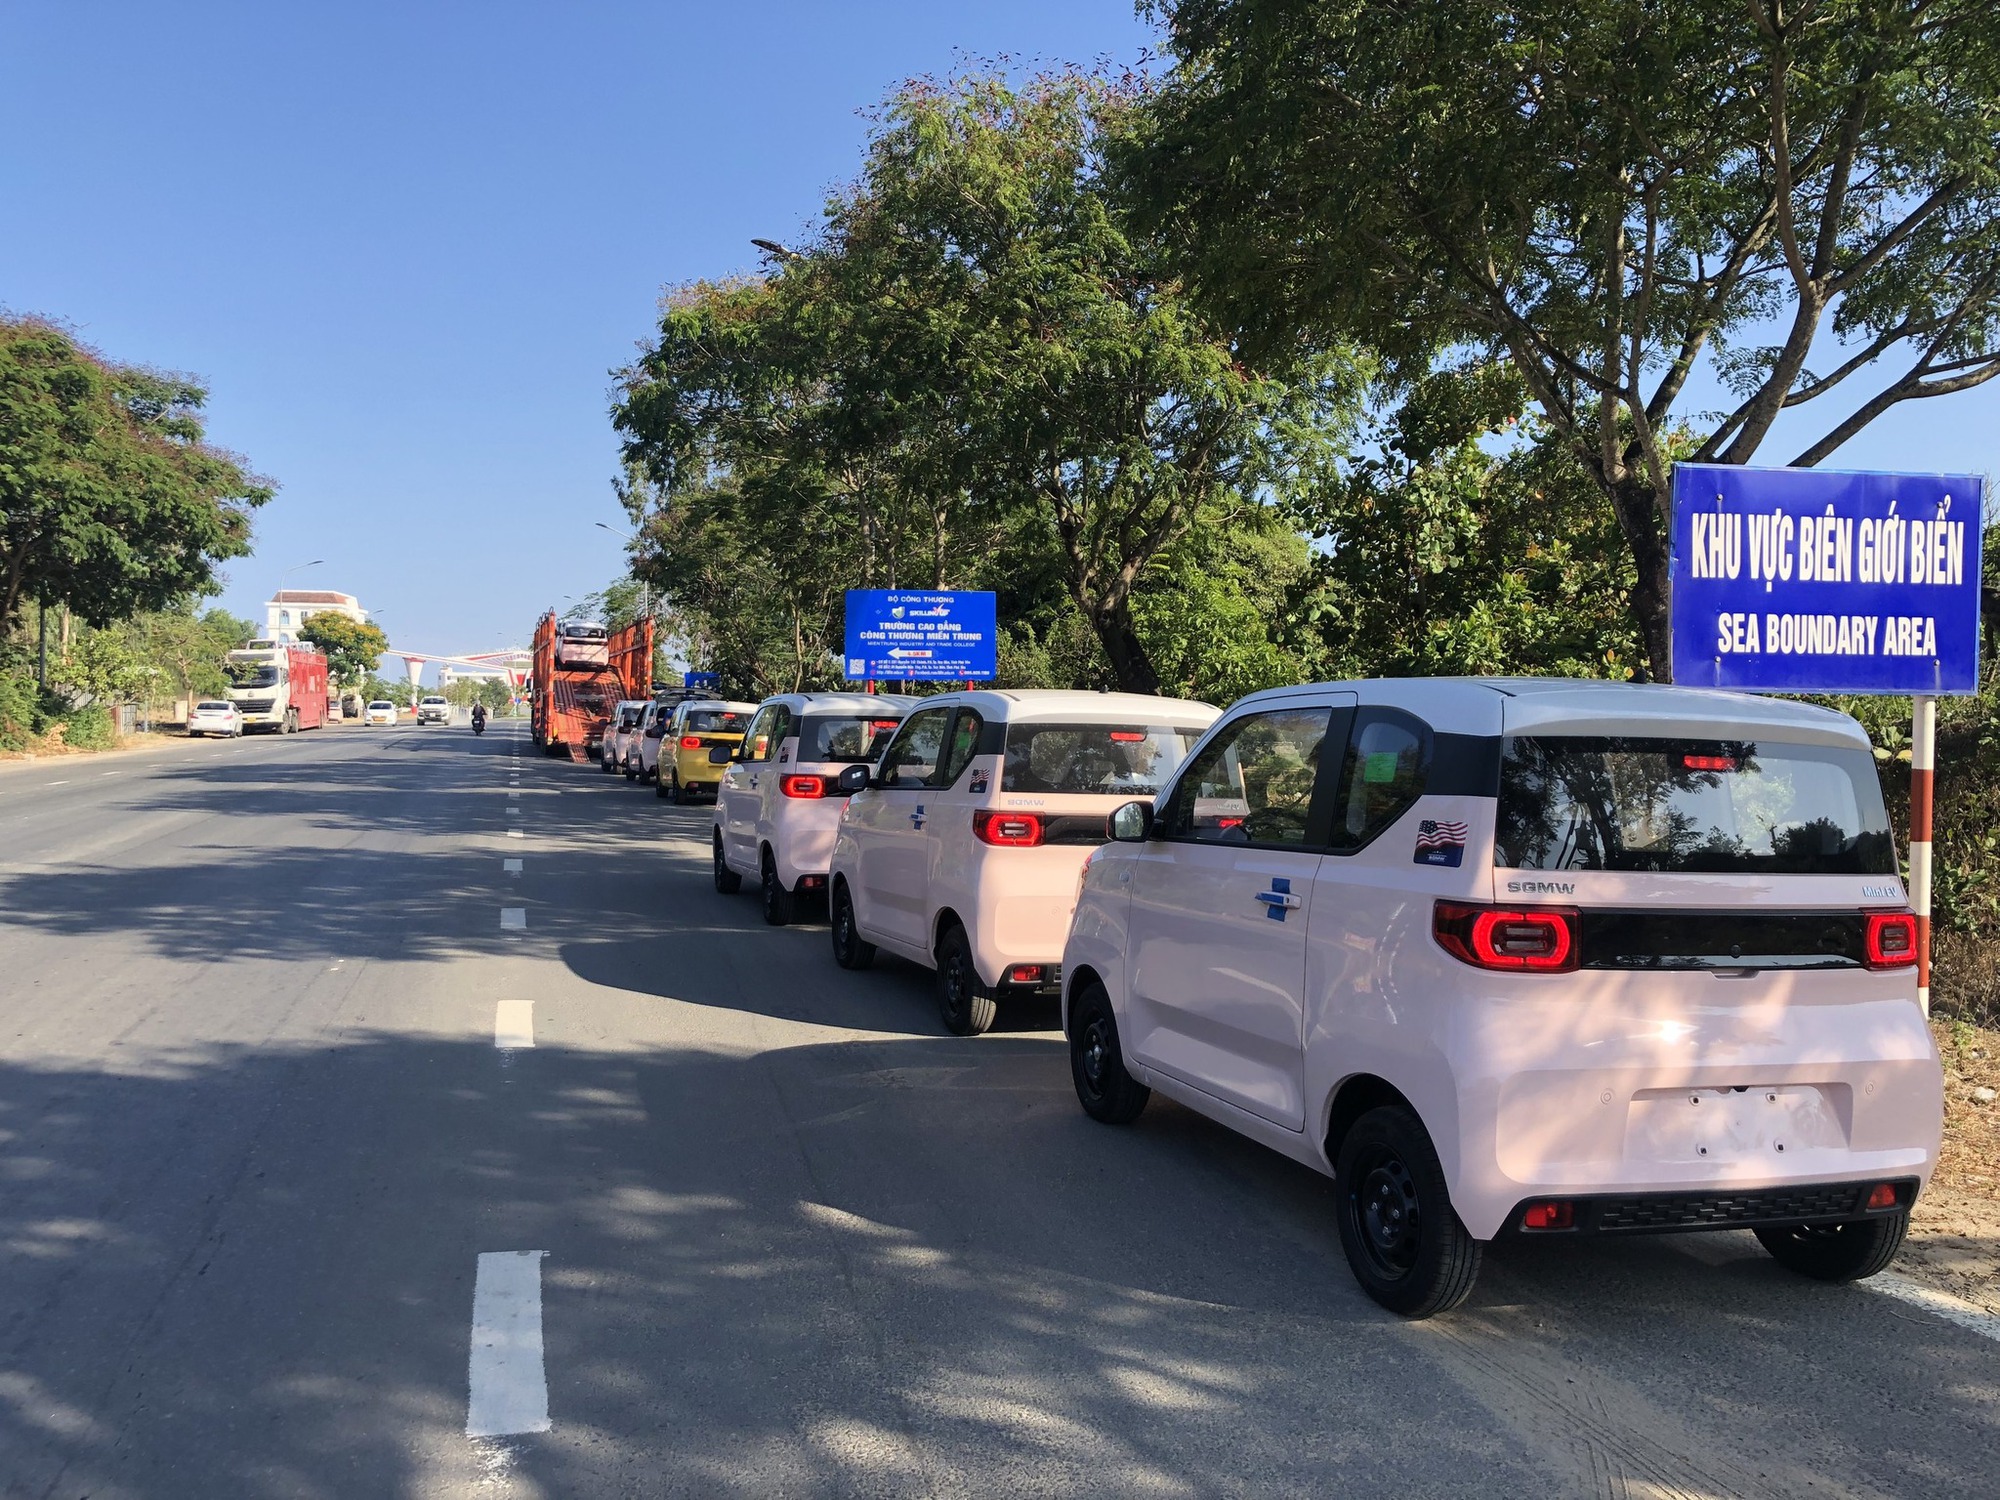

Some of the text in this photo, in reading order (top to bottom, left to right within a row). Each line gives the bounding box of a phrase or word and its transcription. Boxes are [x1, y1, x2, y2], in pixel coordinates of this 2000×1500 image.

[1691, 494, 1964, 592] KHU VỰC BIÊN GIỚI BIỂN
[888, 595, 899, 604] BỘ
[901, 595, 921, 603] CÔNG
[879, 621, 916, 631] TRƯỜNG
[918, 622, 935, 630] CAO
[860, 630, 886, 640] CÔNG
[888, 631, 924, 640] THƯƠNG
[952, 632, 982, 640] TRUNG
[1718, 612, 1937, 657] SEA BOUNDARY AREA
[1507, 881, 1576, 894] SGMW
[1885, 887, 1897, 898] EV
